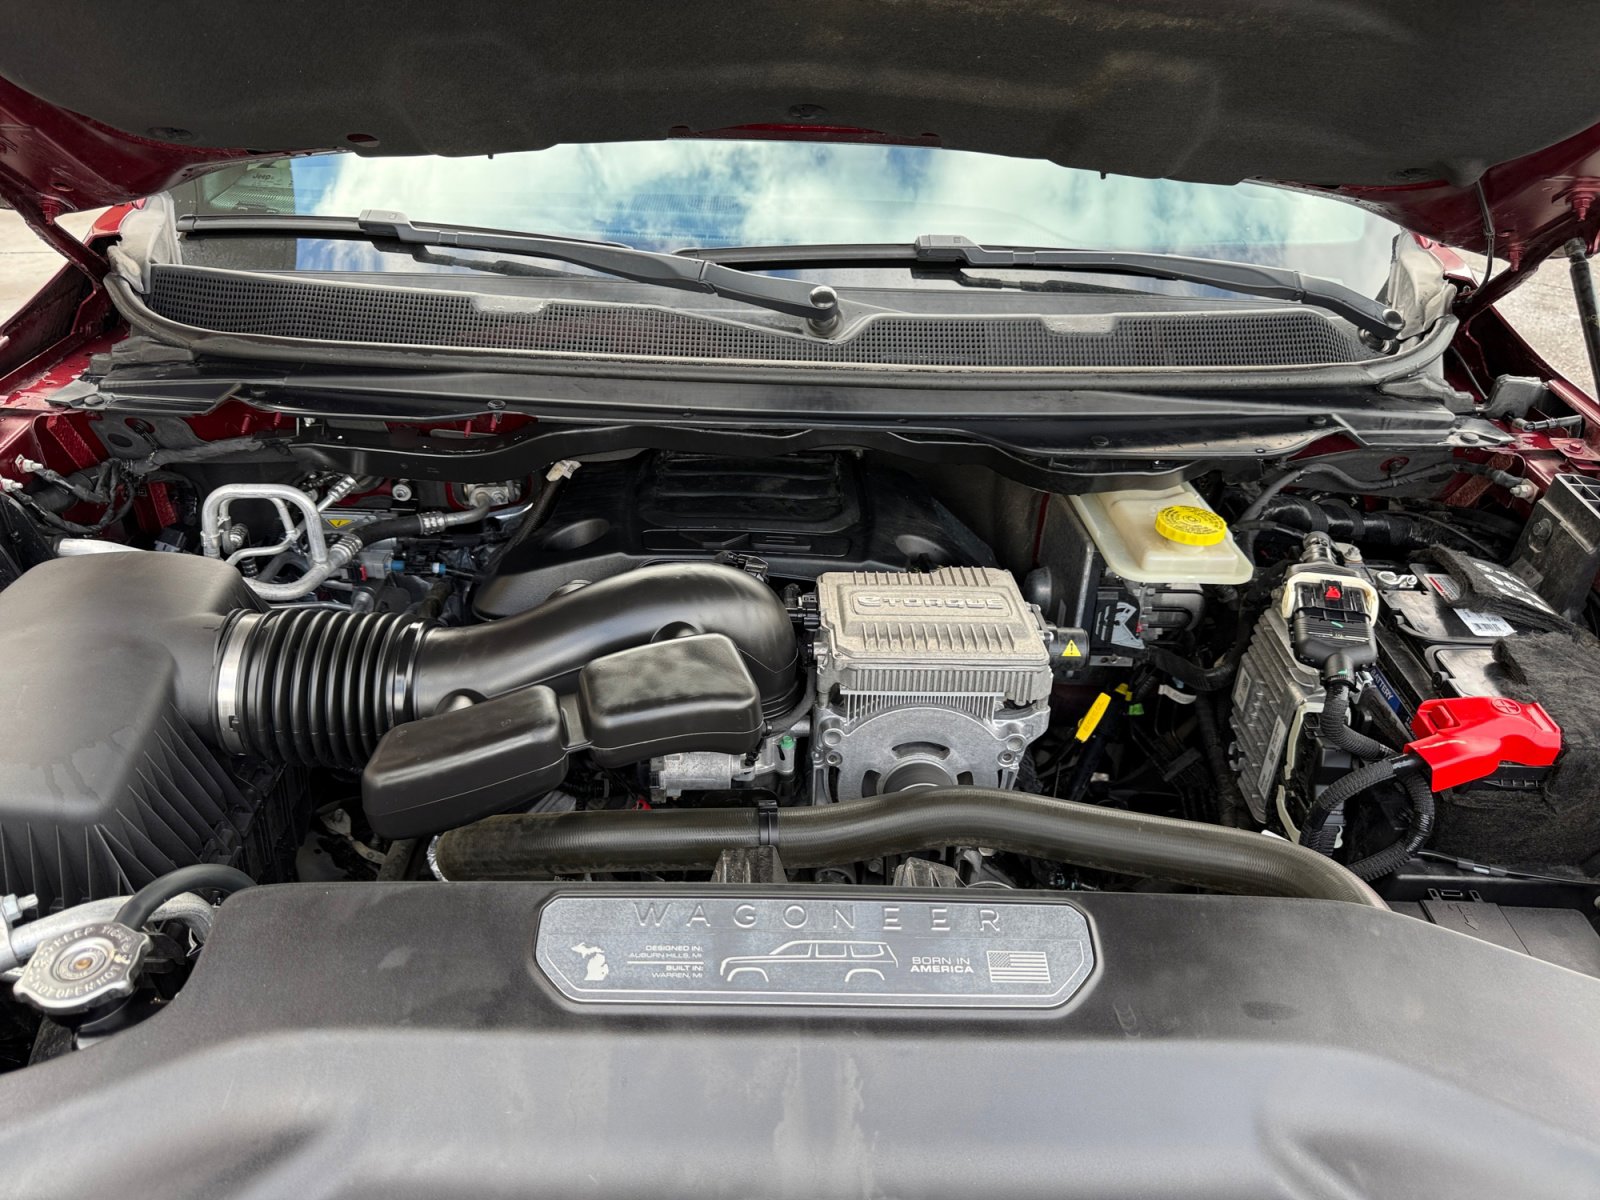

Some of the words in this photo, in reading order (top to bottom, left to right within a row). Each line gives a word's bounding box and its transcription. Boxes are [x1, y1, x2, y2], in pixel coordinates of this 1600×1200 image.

[1370, 668, 1394, 700] BATTERY
[633, 902, 1001, 932] WAGONEER
[910, 965, 974, 974] AMERICA
[911, 956, 952, 965] BORN
[956, 957, 970, 965] IN
